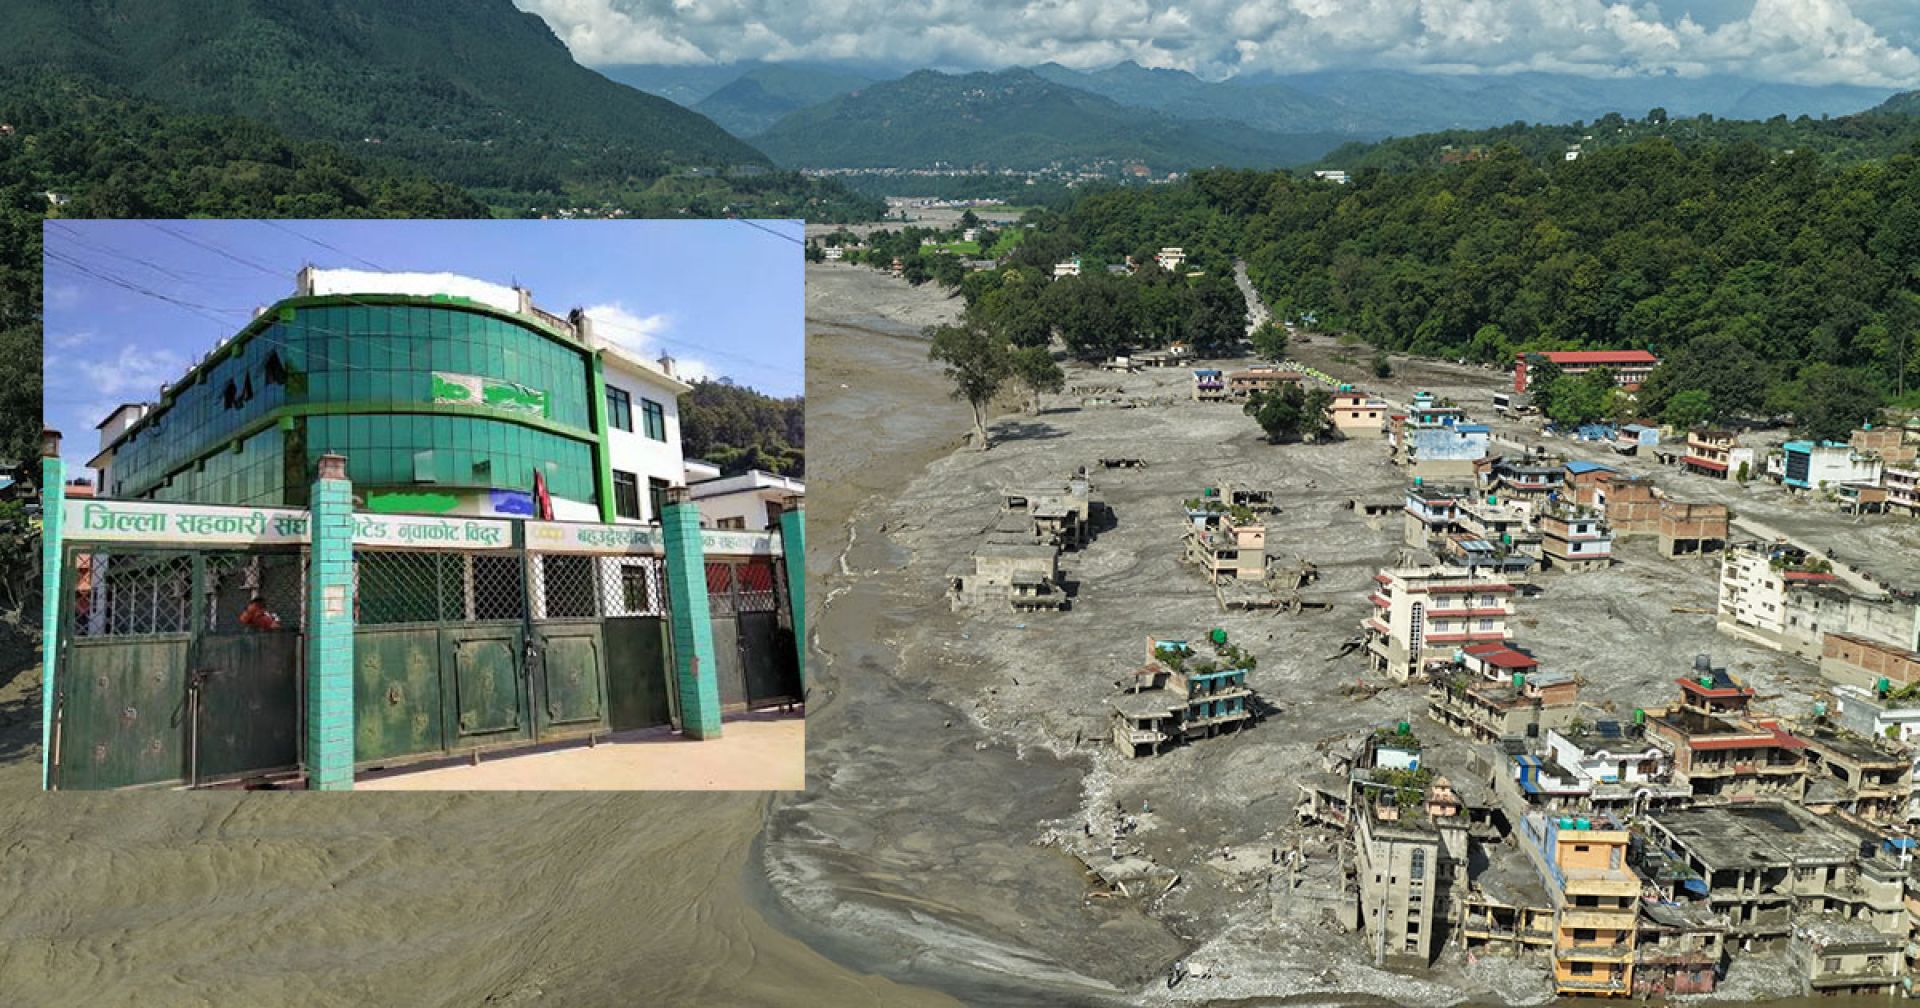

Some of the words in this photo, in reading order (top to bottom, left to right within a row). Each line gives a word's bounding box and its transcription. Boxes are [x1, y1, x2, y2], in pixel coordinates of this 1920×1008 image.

[83, 503, 168, 532] जिल्ला
[176, 511, 267, 535] सहकारी
[272, 514, 308, 536] संघ
[397, 520, 460, 543] नुवाकोट
[465, 521, 503, 544] विदुर
